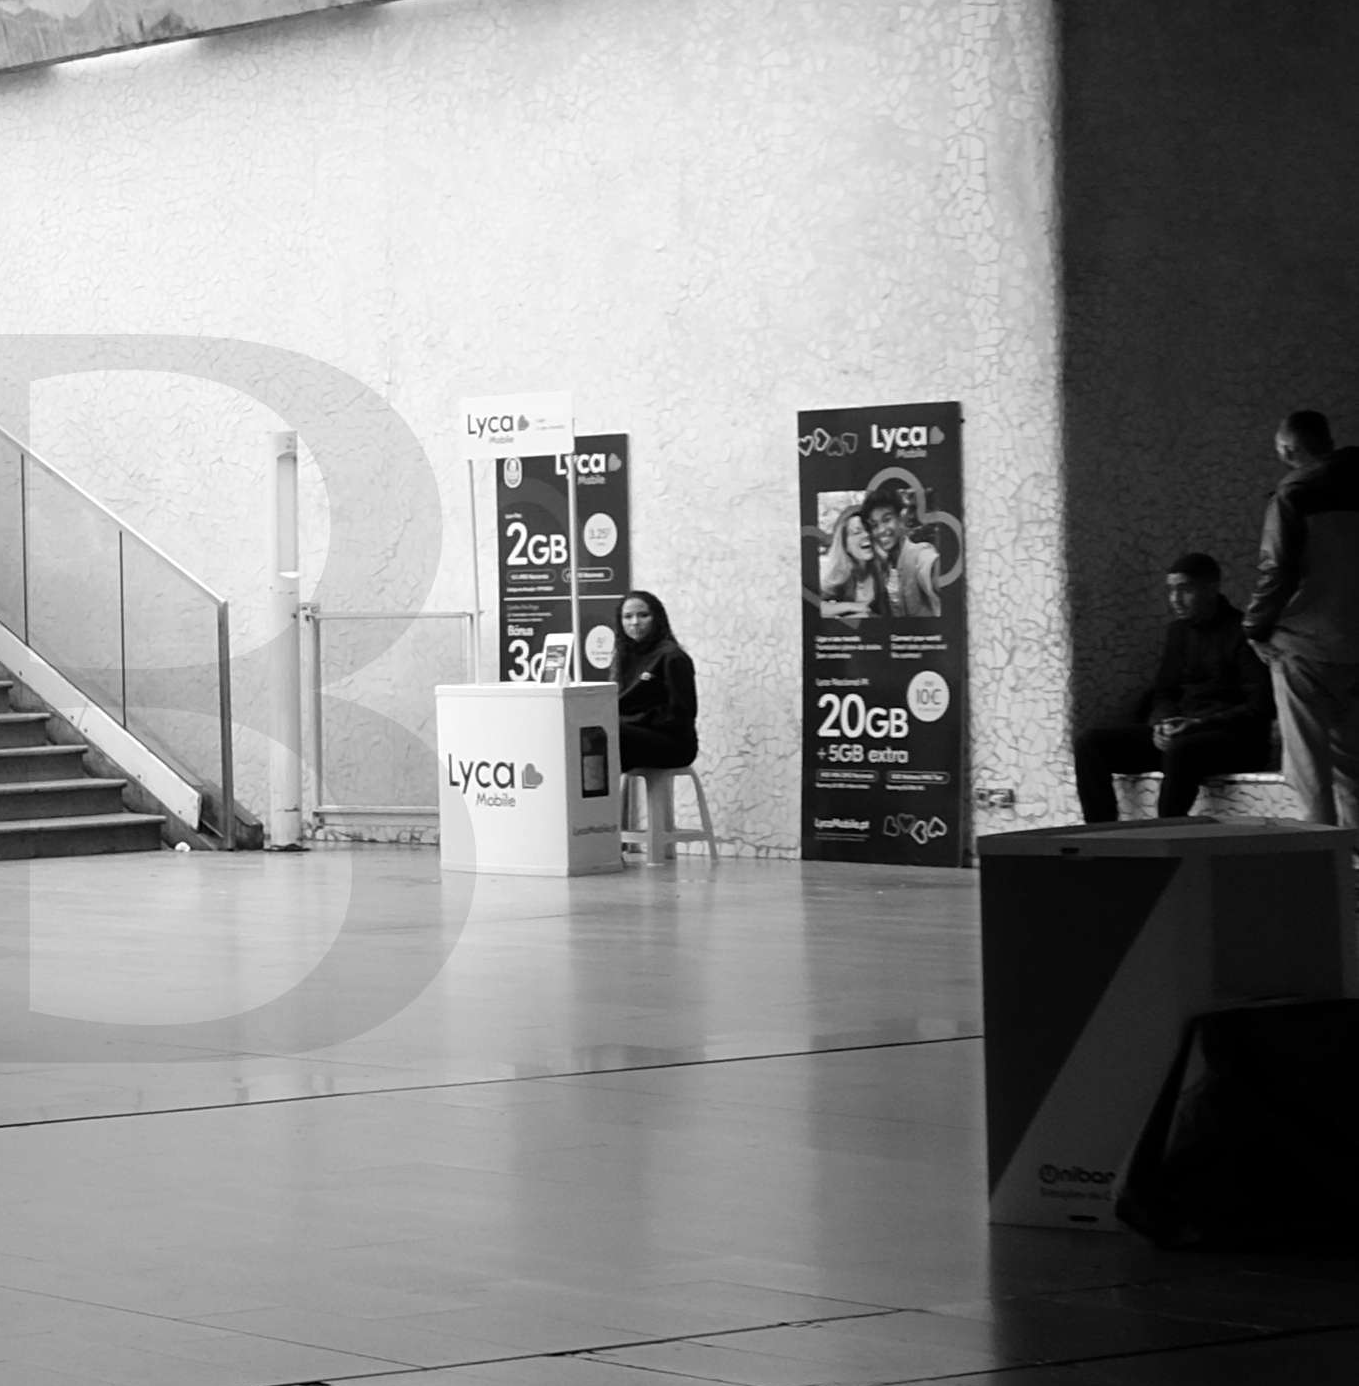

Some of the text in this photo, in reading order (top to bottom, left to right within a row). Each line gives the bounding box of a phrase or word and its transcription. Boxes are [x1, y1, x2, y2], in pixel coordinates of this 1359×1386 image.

[467, 414, 514, 438] Lyca
[871, 424, 927, 453] Lyca
[555, 452, 606, 480] Lyca
[506, 522, 568, 566] 2GB
[817, 693, 910, 739] 20GB
[816, 743, 910, 764] +5GB extra
[448, 753, 515, 795] Lyca
[476, 793, 516, 807] Mobile
